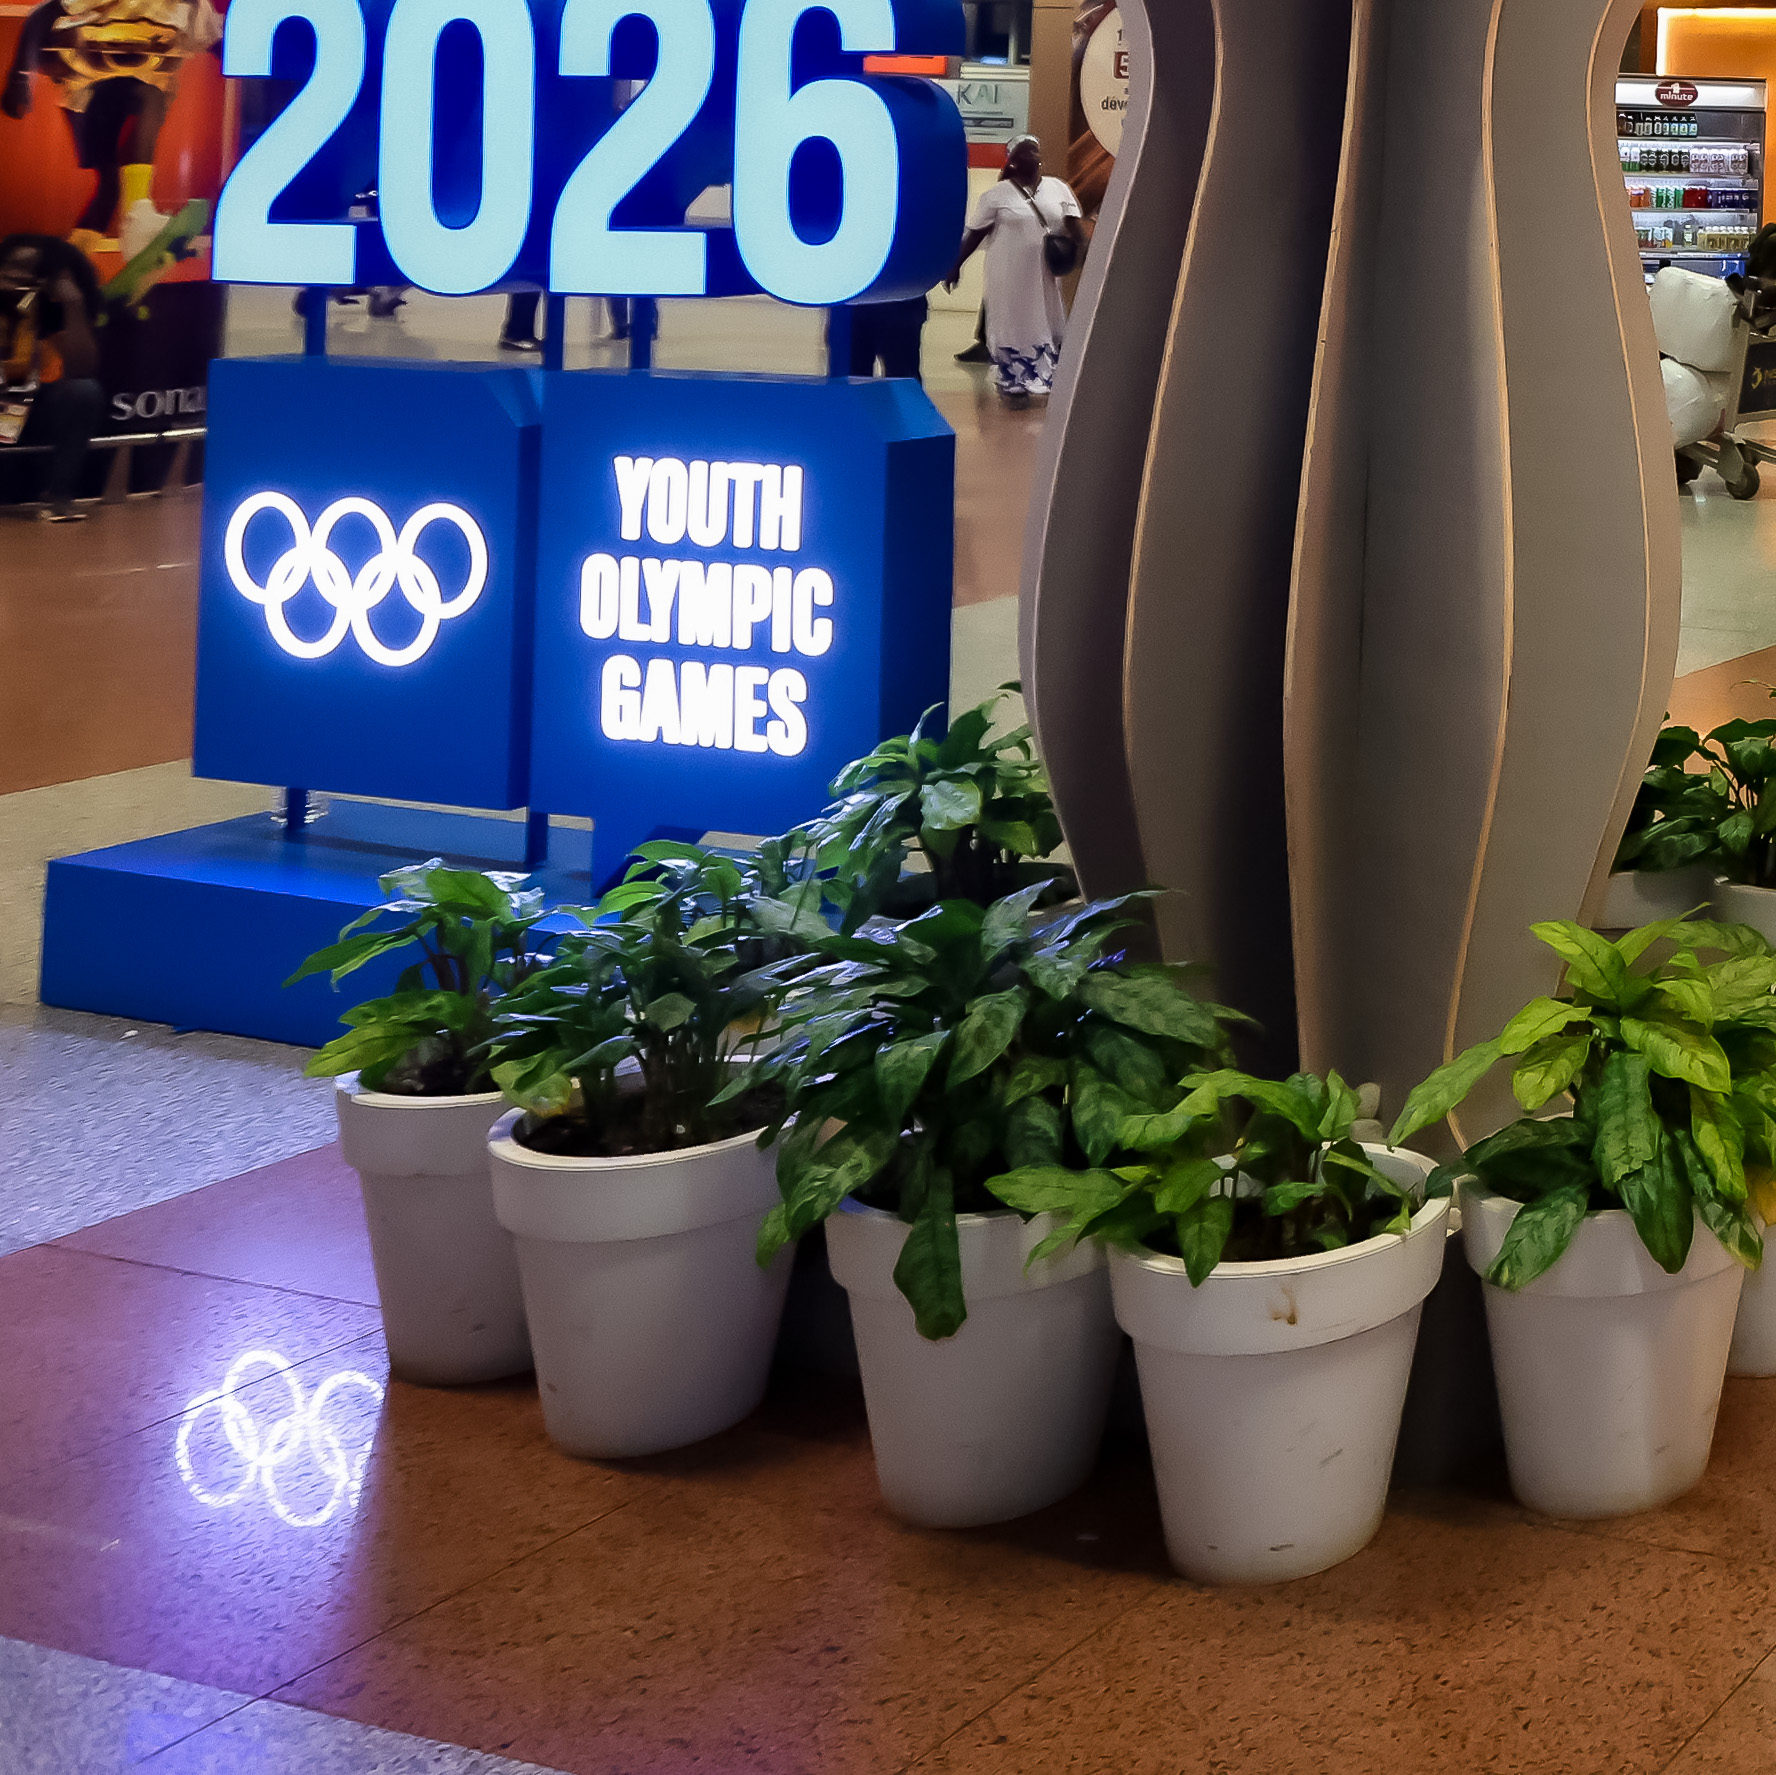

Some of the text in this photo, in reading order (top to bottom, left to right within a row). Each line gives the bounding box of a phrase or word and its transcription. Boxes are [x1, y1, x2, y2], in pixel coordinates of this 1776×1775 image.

[1660, 91, 1693, 102] minute
[613, 455, 804, 552] YOUTH
[579, 552, 834, 656] OLYMPIC
[601, 654, 809, 757] GAMES
